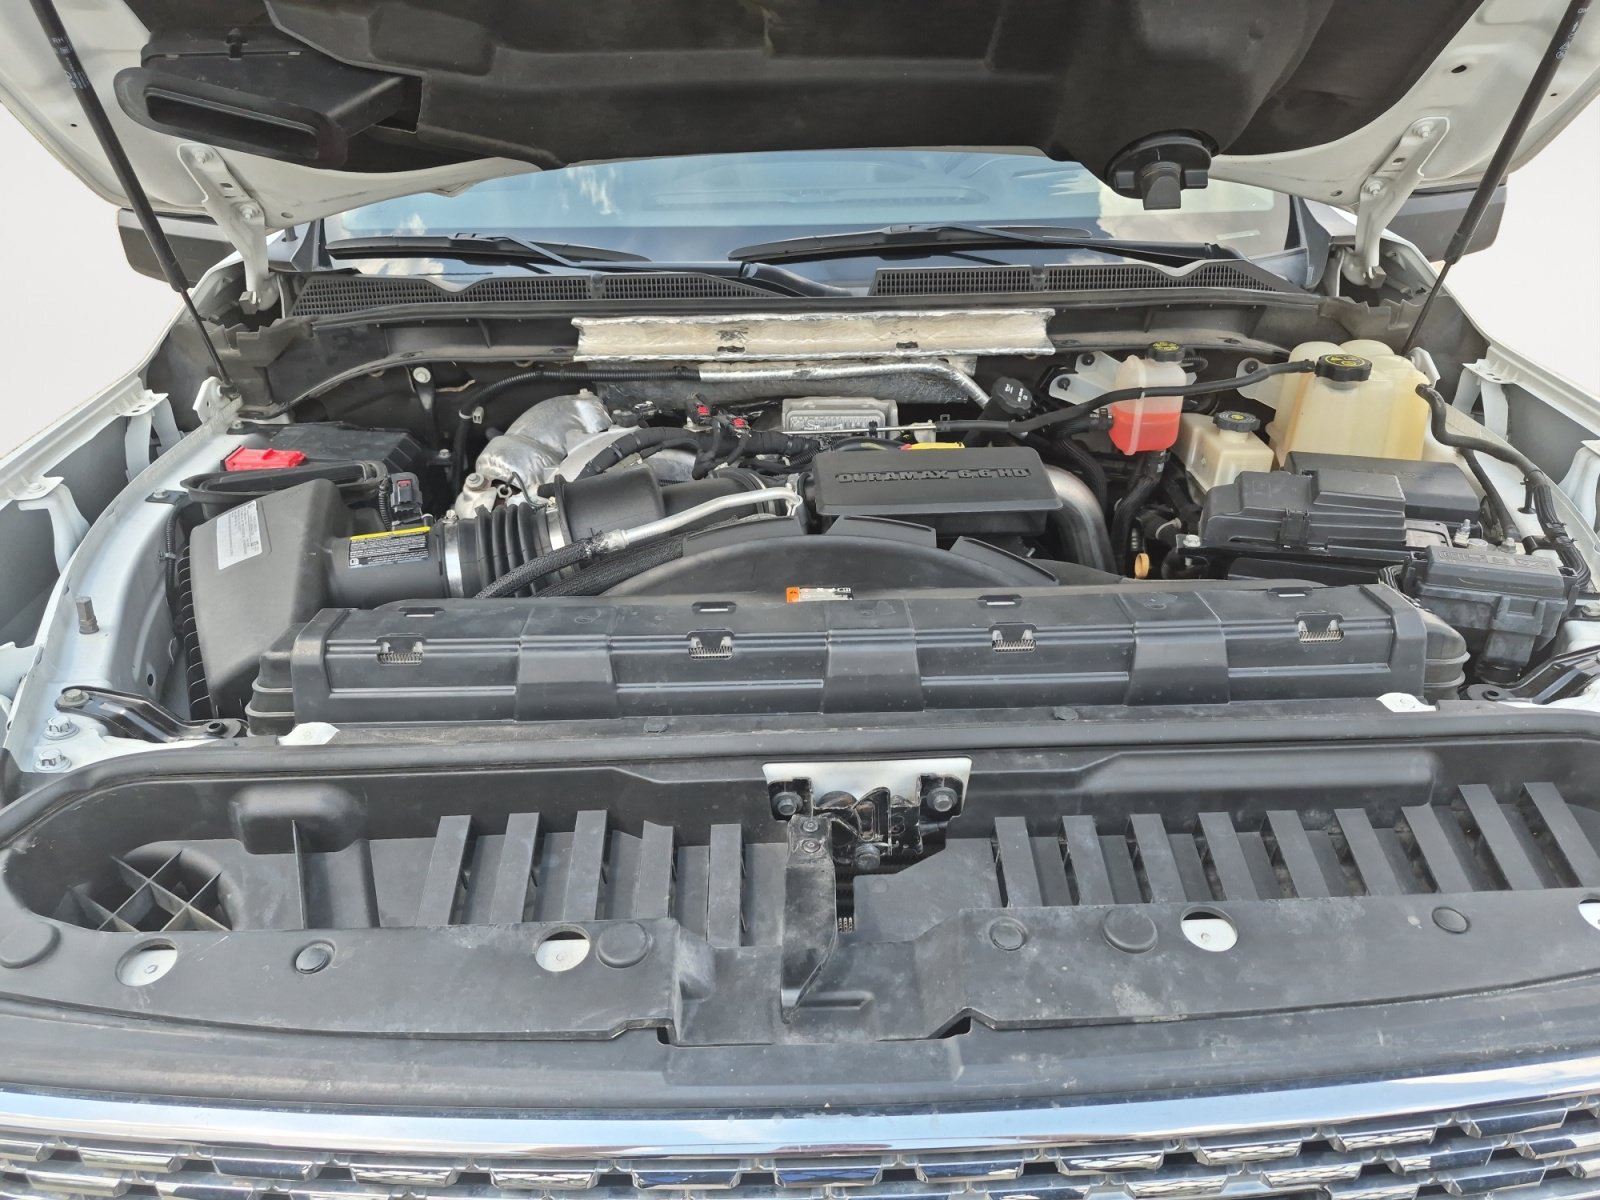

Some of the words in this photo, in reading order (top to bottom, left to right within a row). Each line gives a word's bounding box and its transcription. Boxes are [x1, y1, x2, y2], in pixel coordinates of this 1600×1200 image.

[836, 470, 950, 483] DURAMAX
[957, 469, 993, 479] 6.6
[996, 468, 1030, 478] HD
